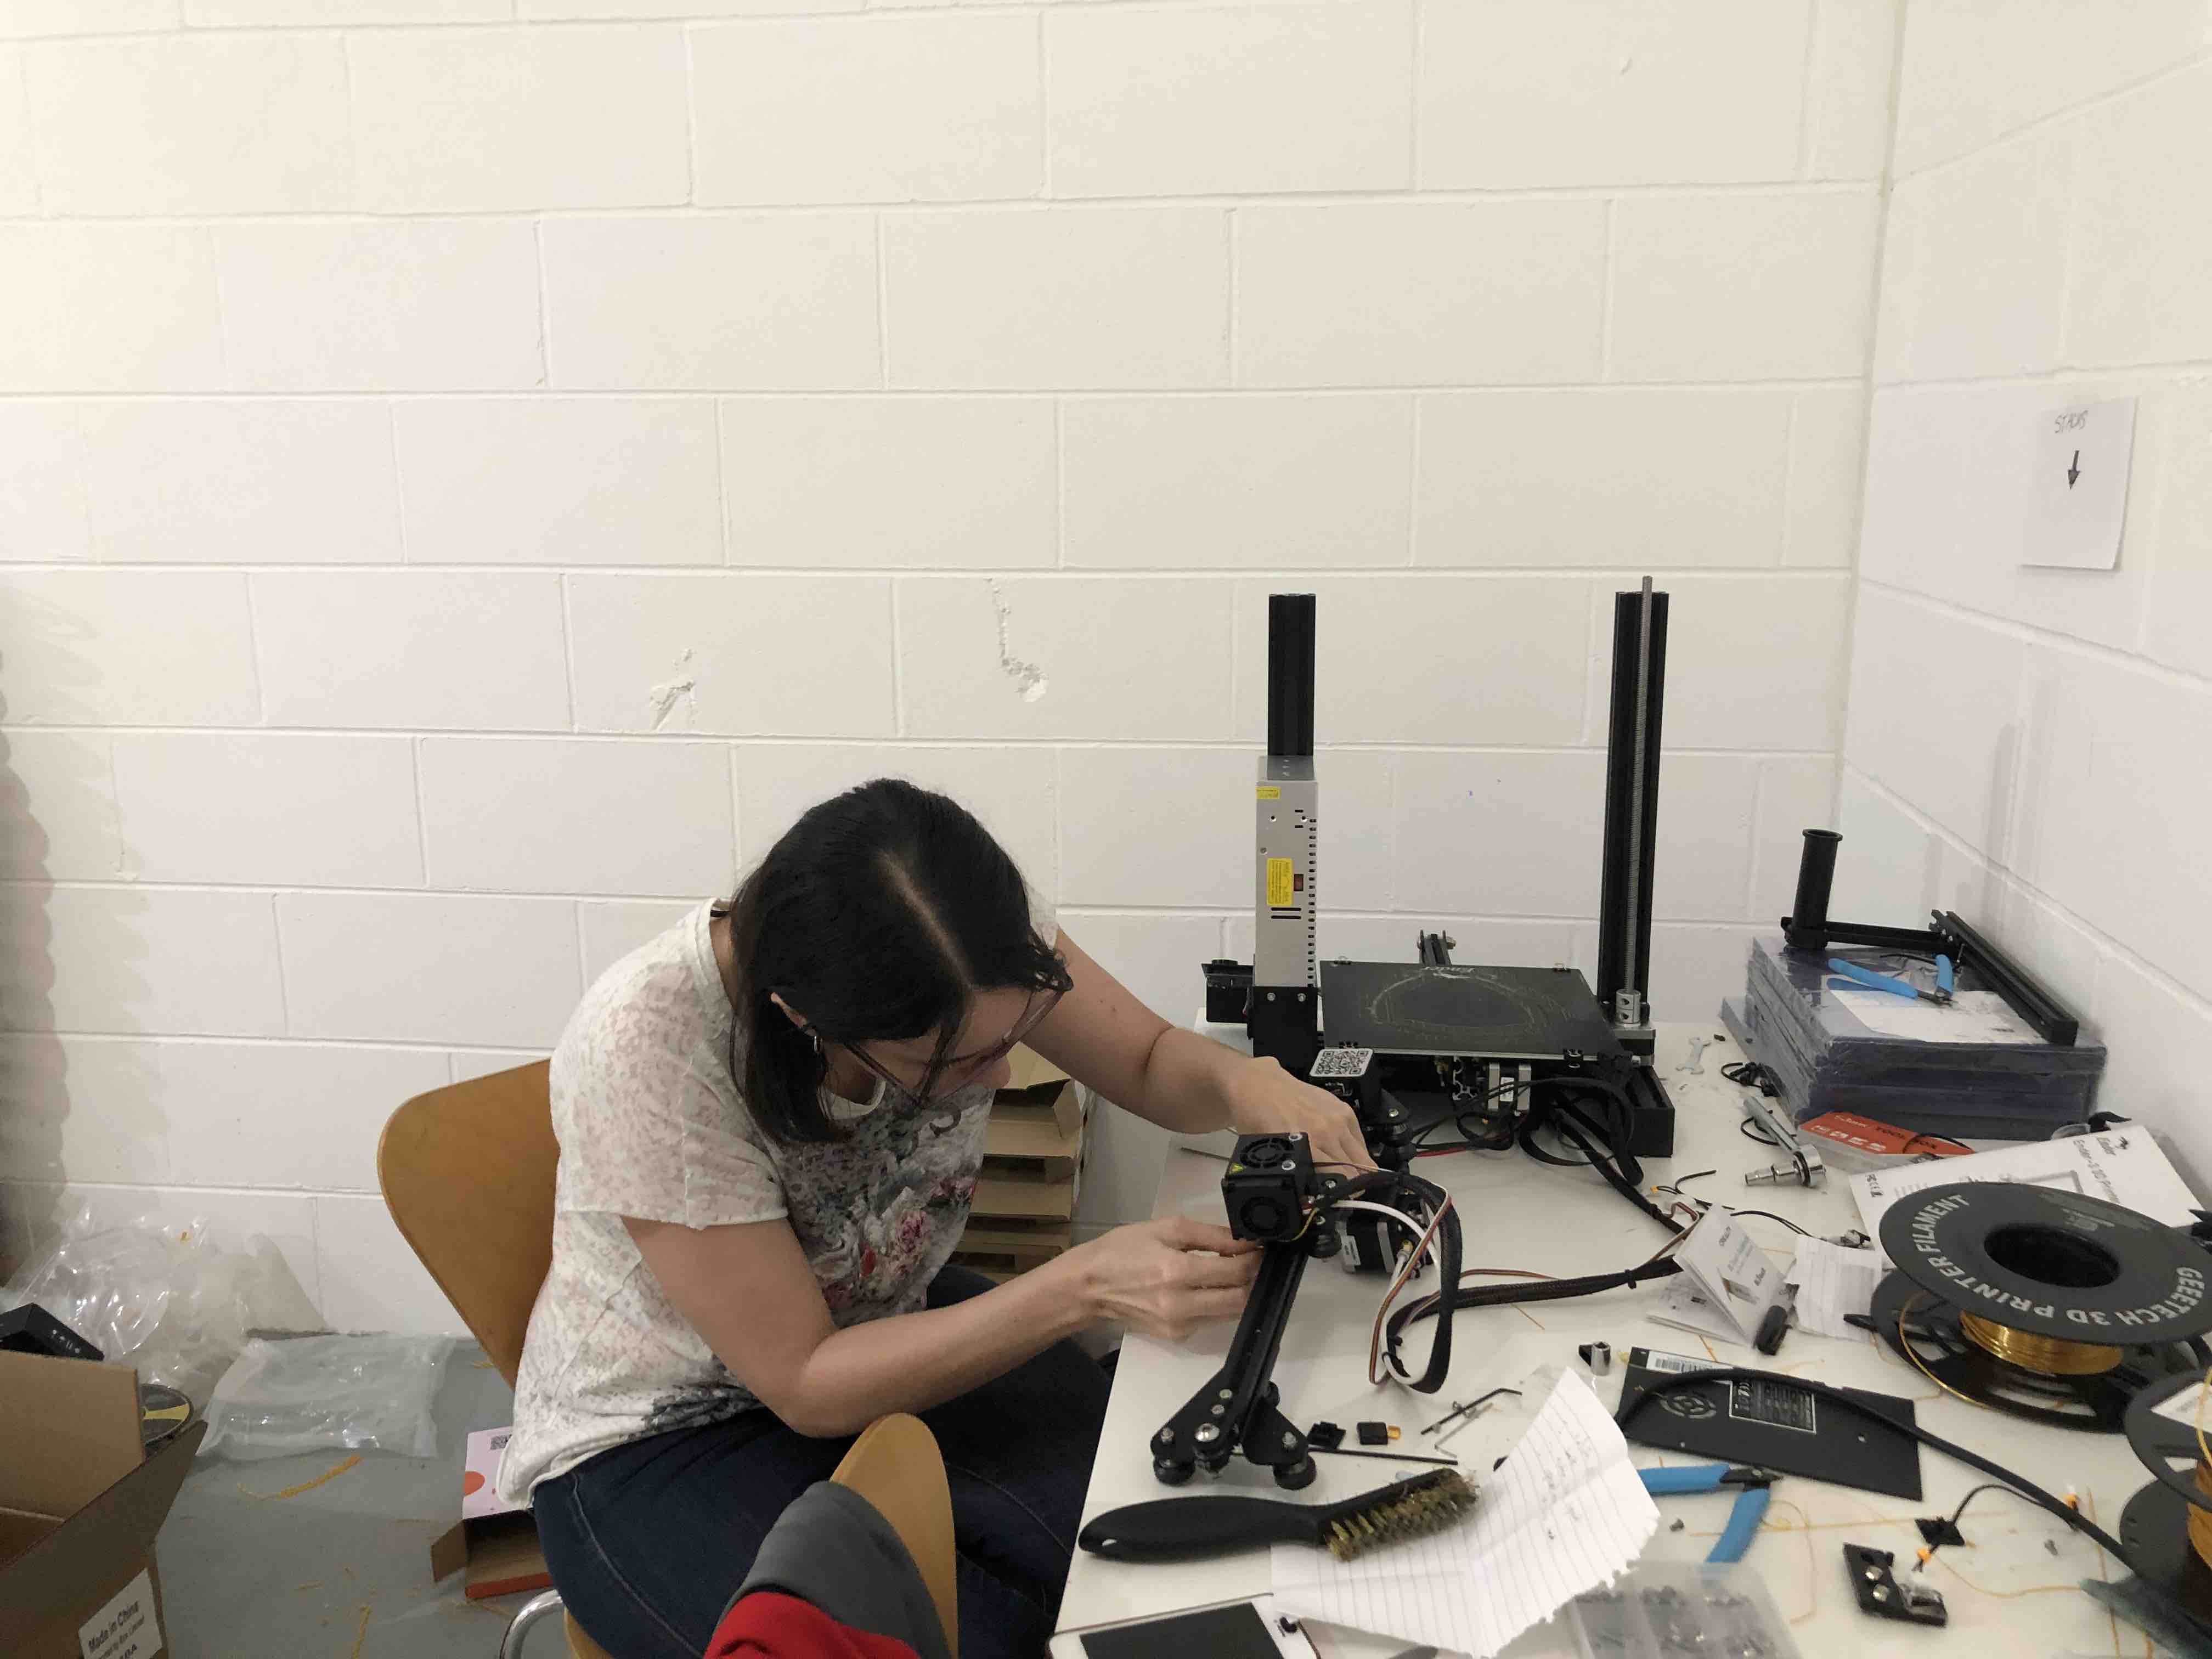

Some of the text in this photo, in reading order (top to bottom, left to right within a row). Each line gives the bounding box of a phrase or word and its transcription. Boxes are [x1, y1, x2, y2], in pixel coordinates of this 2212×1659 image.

[1911, 1194, 2205, 1327] GEEETECH 3D PRINTER FILAMENT
